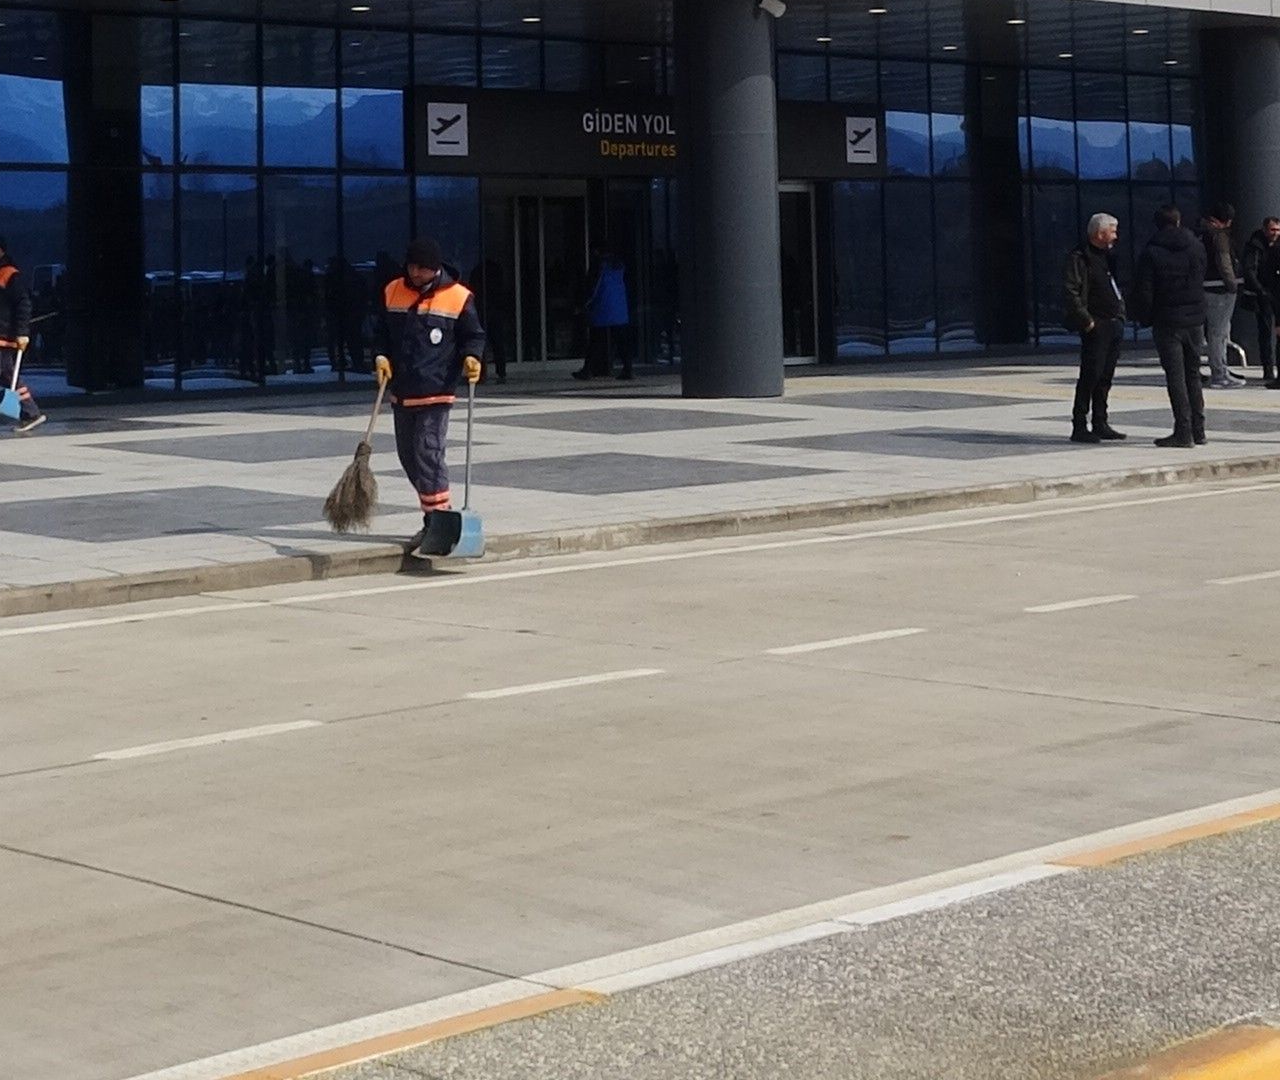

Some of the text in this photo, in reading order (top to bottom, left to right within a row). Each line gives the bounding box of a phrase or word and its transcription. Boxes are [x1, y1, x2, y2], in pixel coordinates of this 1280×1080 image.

[582, 107, 676, 135] GİDEN YOL
[600, 139, 677, 158] Departures
